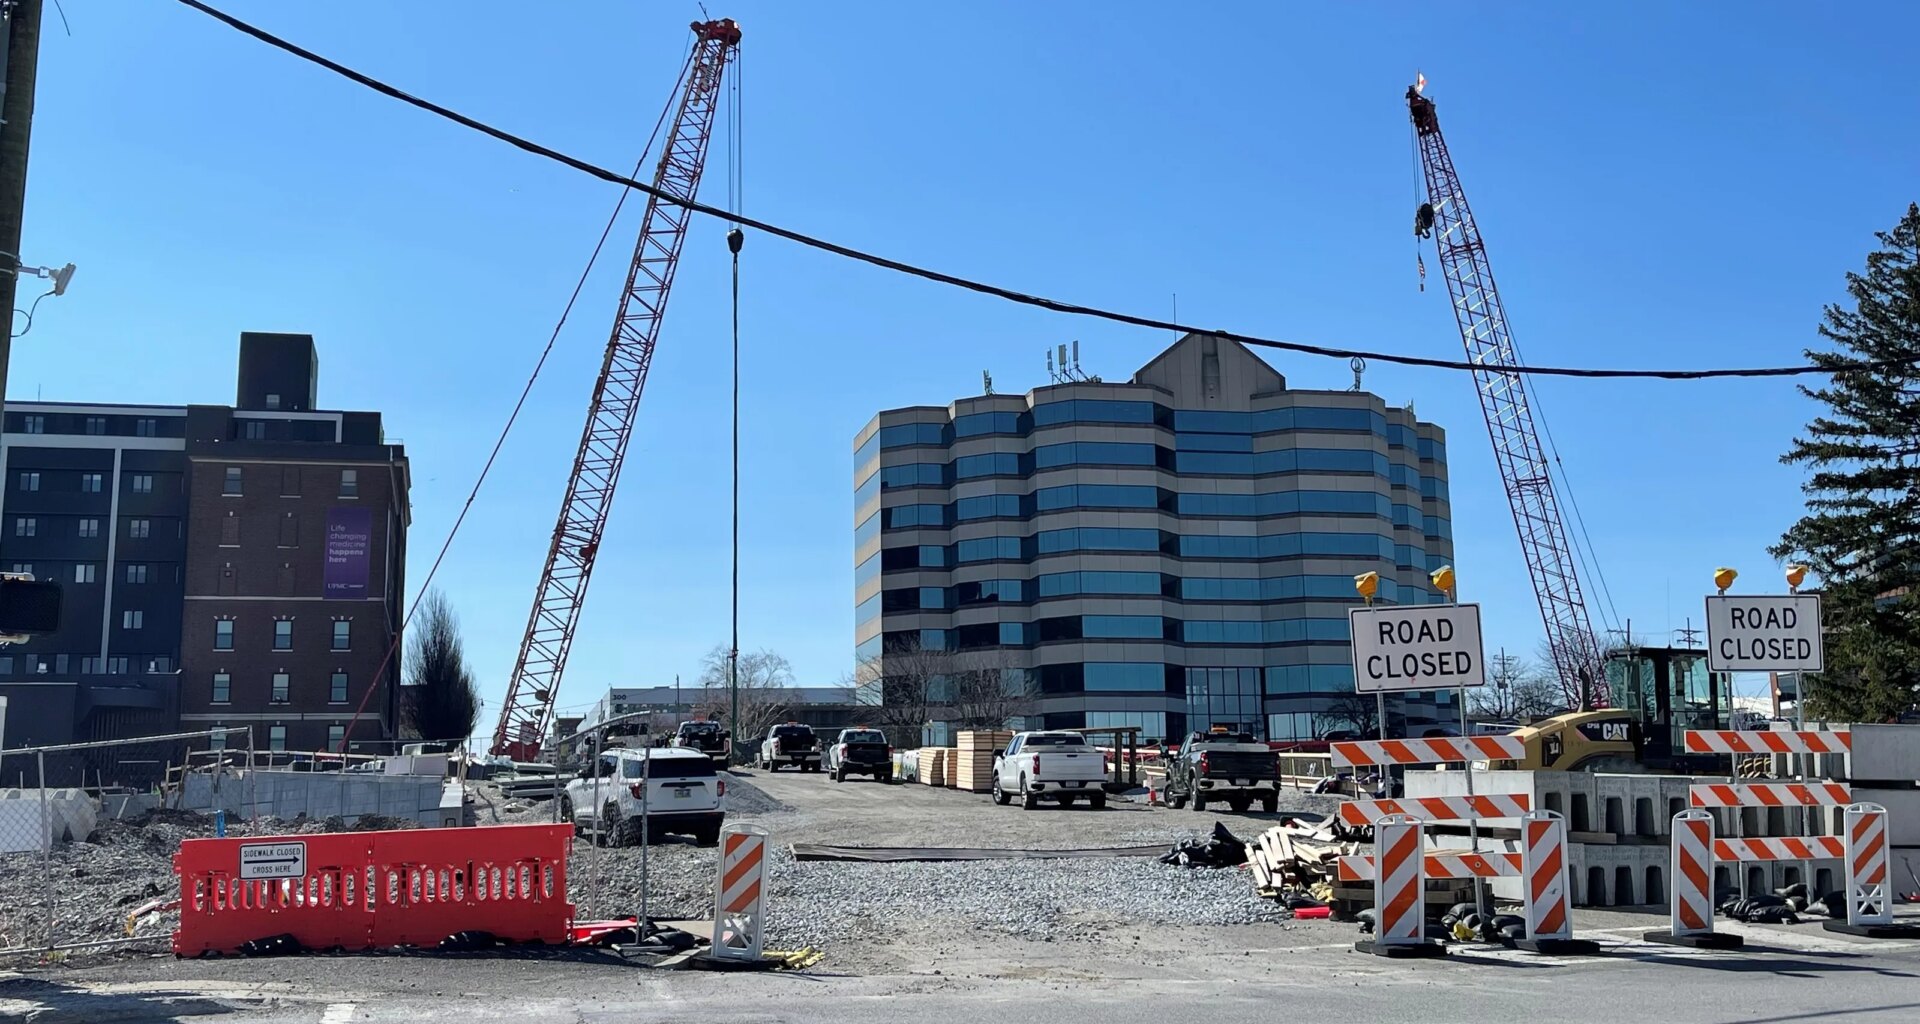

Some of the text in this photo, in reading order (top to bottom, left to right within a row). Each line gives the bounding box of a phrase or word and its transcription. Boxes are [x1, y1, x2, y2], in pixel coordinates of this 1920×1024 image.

[330, 524, 346, 532] Life
[330, 533, 367, 541] changing
[329, 548, 364, 556] happens
[1731, 607, 1797, 629] ROAD
[1378, 619, 1453, 645] ROAD
[1720, 638, 1811, 660] CLOSED
[1367, 651, 1472, 679] CLOSED
[1602, 722, 1629, 741] CAT
[243, 847, 301, 858] SIDEWALK CLOSED
[252, 865, 291, 874] CROSS HERE
